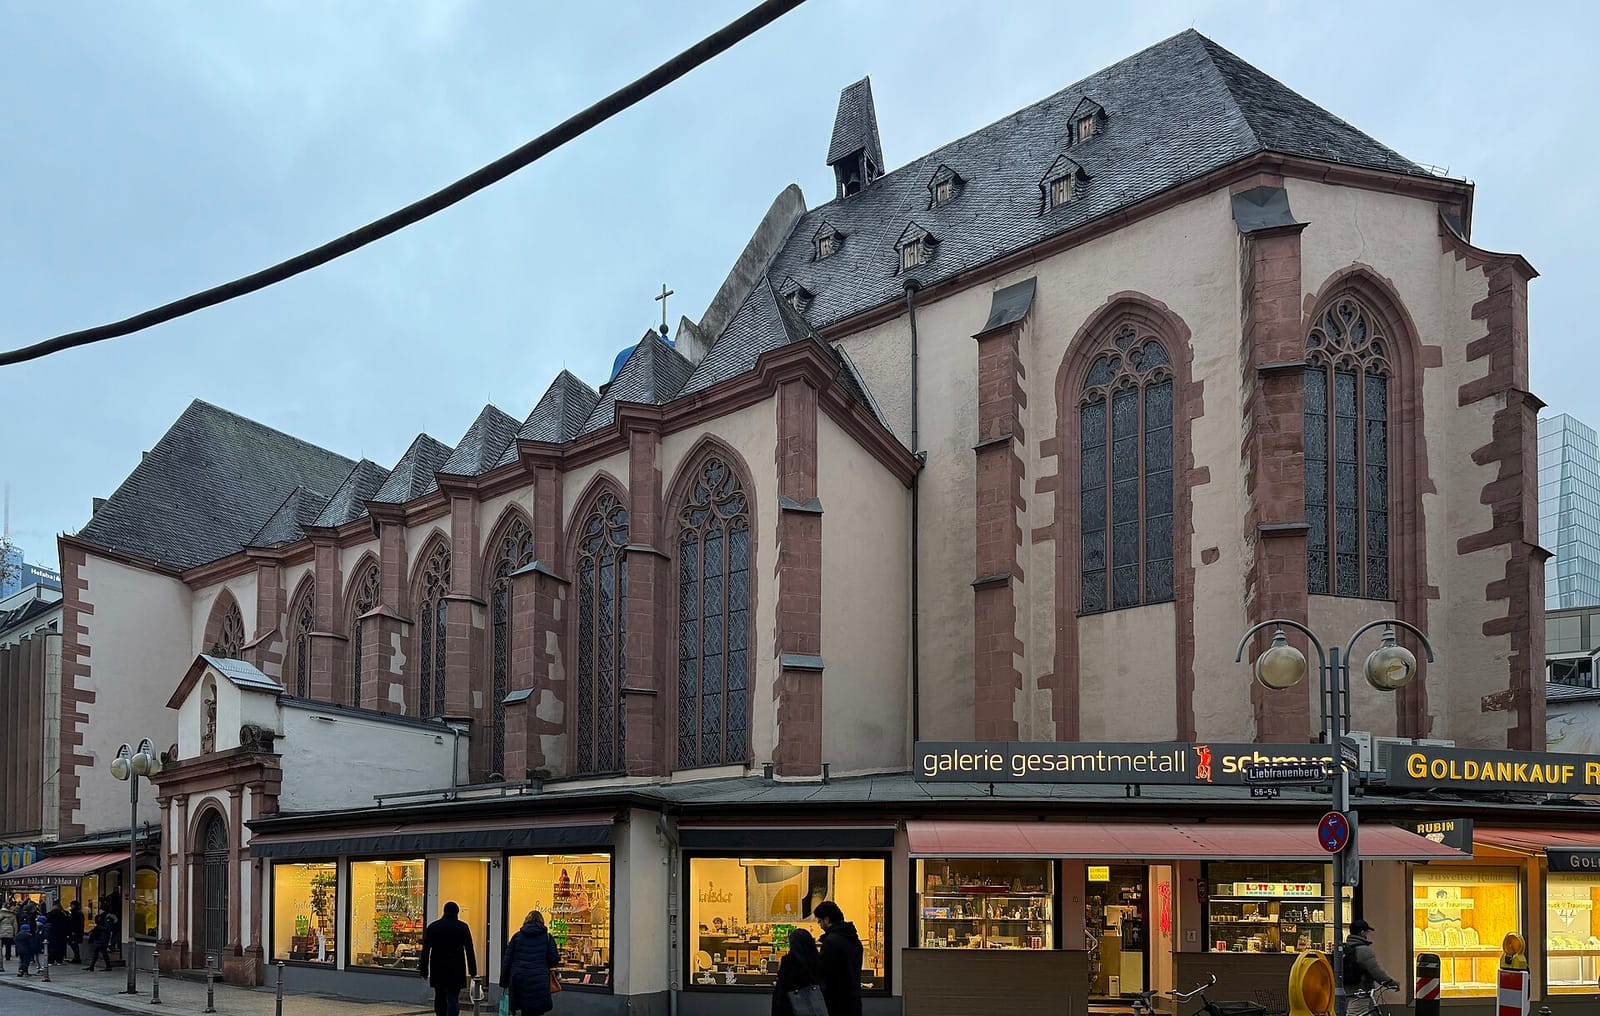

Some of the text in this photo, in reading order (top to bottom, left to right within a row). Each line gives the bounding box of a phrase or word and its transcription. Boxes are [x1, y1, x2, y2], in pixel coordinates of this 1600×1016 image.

[923, 749, 1003, 776] galerie
[1011, 750, 1185, 776] gesamtmetall
[1249, 767, 1319, 779] Liebfrauenberg
[1417, 821, 1454, 834] RUBIN
